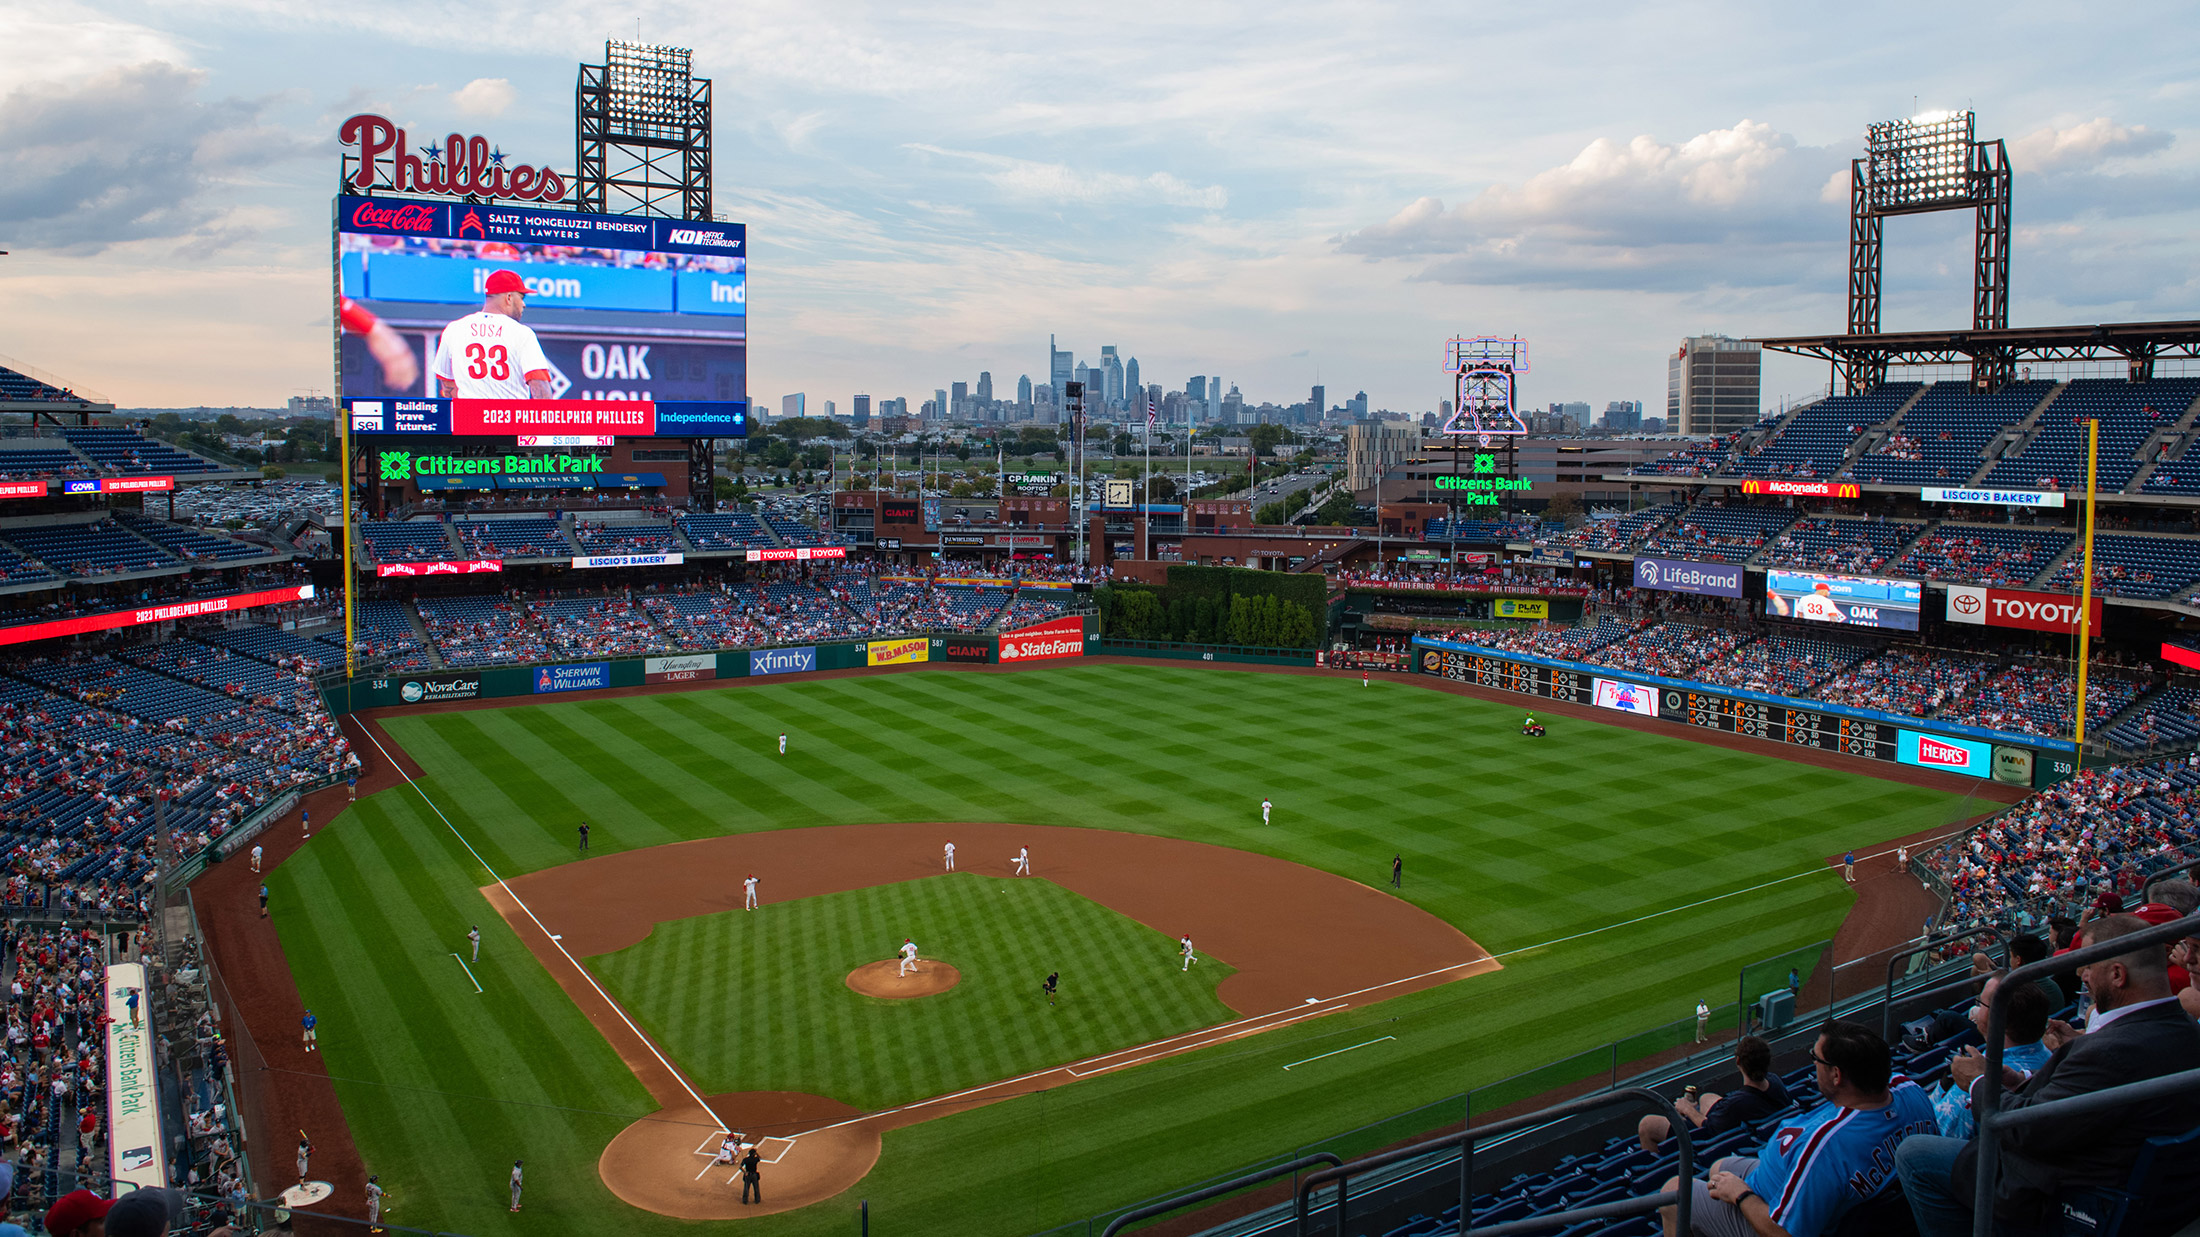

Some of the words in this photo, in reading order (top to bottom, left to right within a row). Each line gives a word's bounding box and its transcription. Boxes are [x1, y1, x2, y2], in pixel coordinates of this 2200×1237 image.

[338, 113, 567, 202] Phillies
[352, 202, 437, 232] Coca-Cola
[488, 213, 520, 225] SALTZ
[525, 217, 592, 230] MONGELUZZI
[596, 221, 648, 234] BENDESKY
[489, 226, 522, 235] TRIAL
[530, 229, 580, 239] LAWYERS
[703, 231, 725, 240] OFFICE
[702, 238, 741, 248] TECHNOLOGY
[470, 323, 503, 338] SOSA
[465, 343, 510, 380] 33
[581, 343, 652, 380] OAK
[395, 402, 438, 413] Building
[395, 412, 425, 421] brave
[483, 409, 511, 424] 2023
[515, 410, 592, 424] PHILADELPHIA
[596, 411, 644, 425] PHILLIES
[660, 412, 731, 425] Independence
[415, 456, 501, 475] Citizens
[504, 454, 556, 474] Bank
[559, 454, 604, 473] Park
[149, 480, 167, 488] PHILLIES
[1008, 475, 1022, 483] CP
[1023, 475, 1057, 483] RANKIN
[1435, 476, 1493, 490] Citizens
[1495, 477, 1532, 491] Bank
[17, 485, 39, 494] PHILLIES
[71, 482, 95, 492] GOYA
[1769, 481, 1829, 495] McDonald's
[1467, 491, 1499, 506] Park
[1942, 490, 1990, 501] LISCIO'S
[1994, 492, 2042, 504] BAKERY
[885, 509, 916, 517] GIANT
[762, 550, 796, 560] TOYOTA
[811, 548, 844, 558] TOYOTA
[589, 557, 628, 566] LISCIO'S
[630, 555, 667, 564] BAKERY
[382, 566, 395, 577] JIM
[395, 563, 415, 575] BEAM
[425, 565, 438, 575] JIM
[438, 562, 458, 574] BEAM
[467, 563, 481, 573] JIM
[481, 560, 499, 572] BEAM
[1663, 567, 1737, 589] LifeBrand
[1386, 581, 1436, 590] #HITTHEBUDS
[1489, 585, 1540, 595] #HITTHEBUDS
[136, 610, 154, 623] 2023
[154, 602, 199, 620] PHILADELPHIA
[200, 599, 228, 613] PHILLIES
[1517, 603, 1542, 611] PLAY
[1807, 602, 1823, 615] 33
[1849, 606, 1879, 620] OAK
[932, 639, 943, 647] 387
[1089, 633, 1100, 641] 409
[855, 644, 866, 652] 374
[947, 646, 989, 657] GIANT
[754, 650, 812, 673] xfinity
[1202, 653, 1213, 661] 401
[658, 658, 704, 672] Yuengling
[554, 667, 600, 679] SHERWIN
[667, 671, 696, 681] LAGER
[372, 680, 389, 689] 334
[423, 679, 479, 694] NovaCare
[424, 691, 477, 700] REHABILITATION
[1789, 700, 1818, 708] Independence
[1810, 714, 1821, 722] CLE
[1886, 714, 1918, 724] Independence
[1948, 725, 1969, 733] ibx.com
[1757, 721, 1769, 730] CHC
[1811, 722, 1819, 730] SF
[1841, 719, 1850, 727] 38
[1864, 723, 1877, 731] OAK
[1757, 729, 1768, 738] COL
[1864, 731, 1877, 740] HOU
[1993, 732, 2029, 742] Independence
[1809, 739, 1820, 748] LAD
[1863, 741, 1876, 749] LAA
[1864, 749, 1876, 758] SEA
[1922, 743, 1963, 764] HERR'S
[2000, 754, 2026, 766] WM
[2053, 761, 2072, 774] 330
[118, 1034, 140, 1069] Citizens
[120, 1068, 146, 1096] Bank
[121, 1091, 147, 1116] Park
